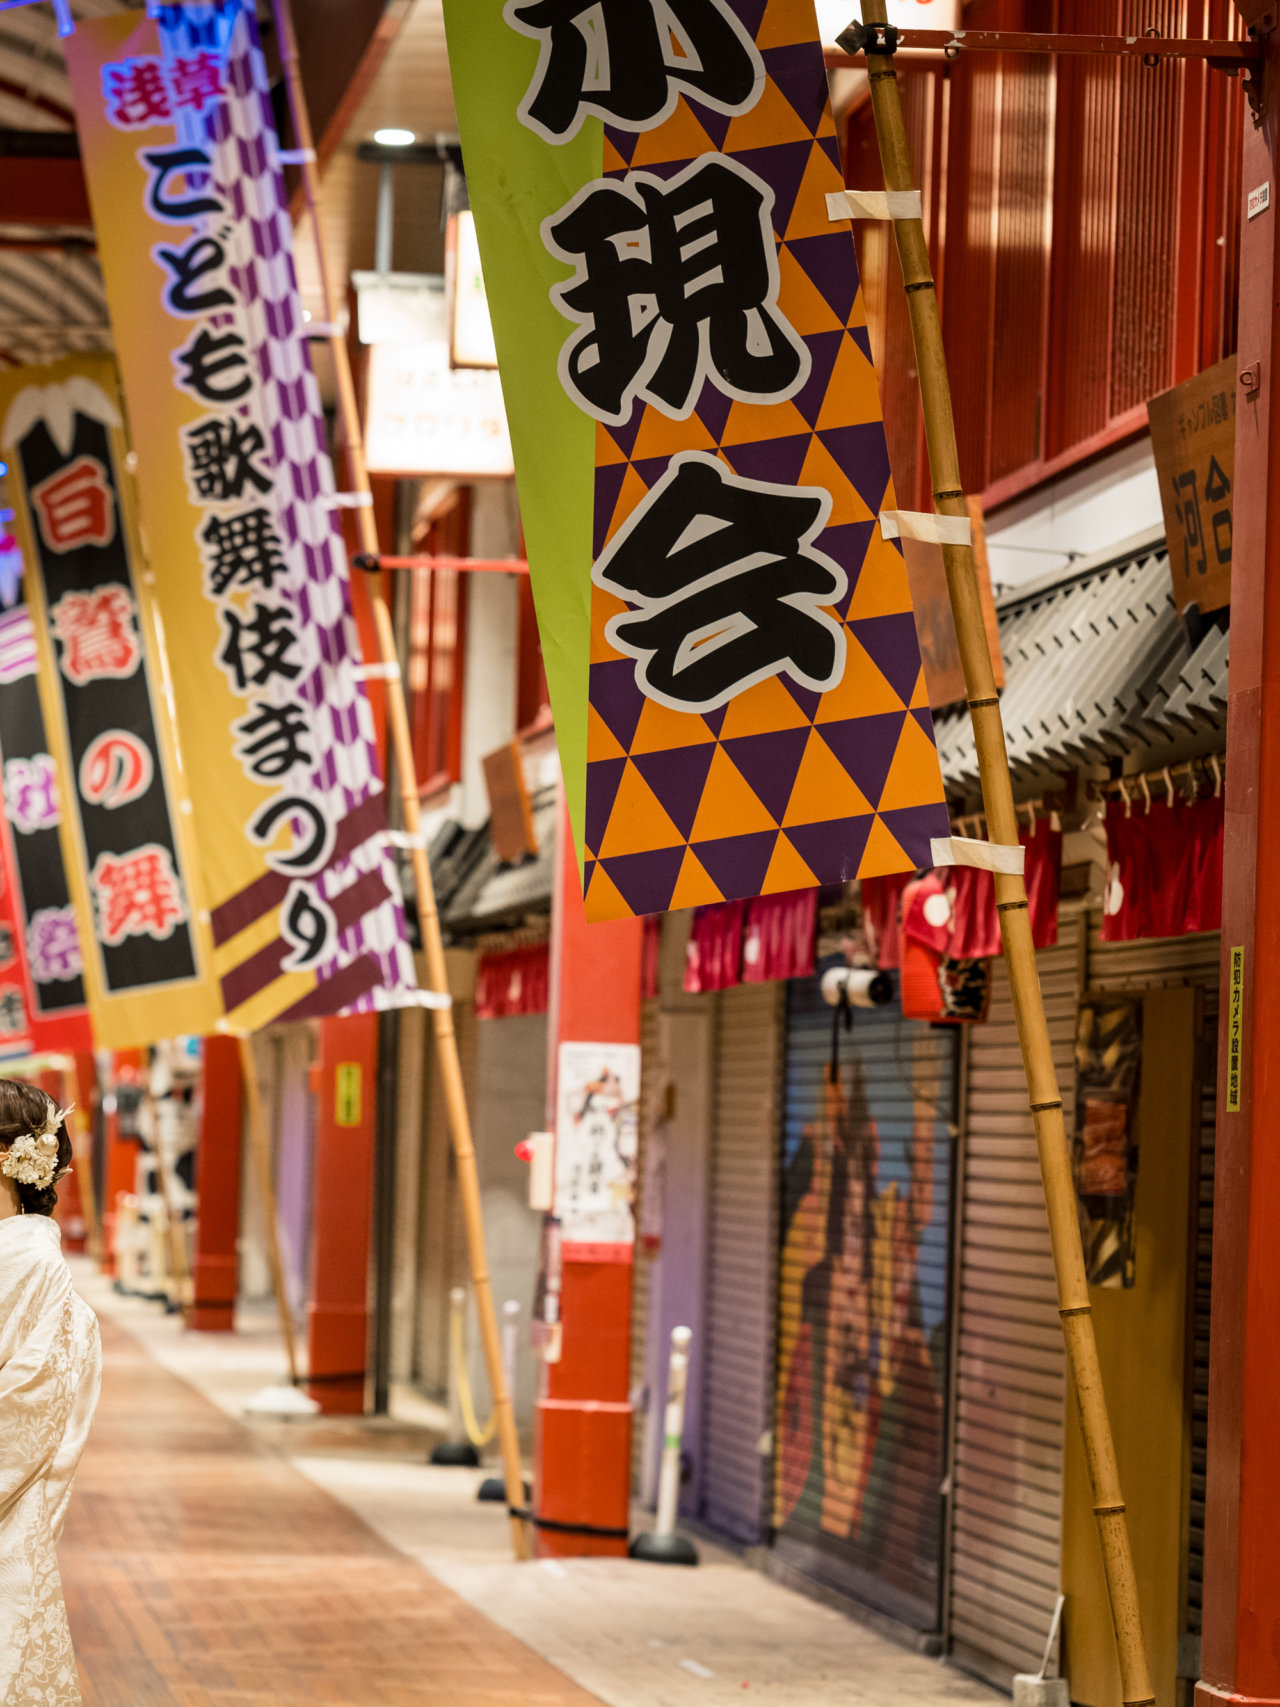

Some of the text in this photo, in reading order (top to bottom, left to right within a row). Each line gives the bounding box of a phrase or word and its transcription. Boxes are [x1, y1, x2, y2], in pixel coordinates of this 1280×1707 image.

[106, 49, 228, 126] 浅草
[144, 148, 329, 968] こども歌舞伎まつり
